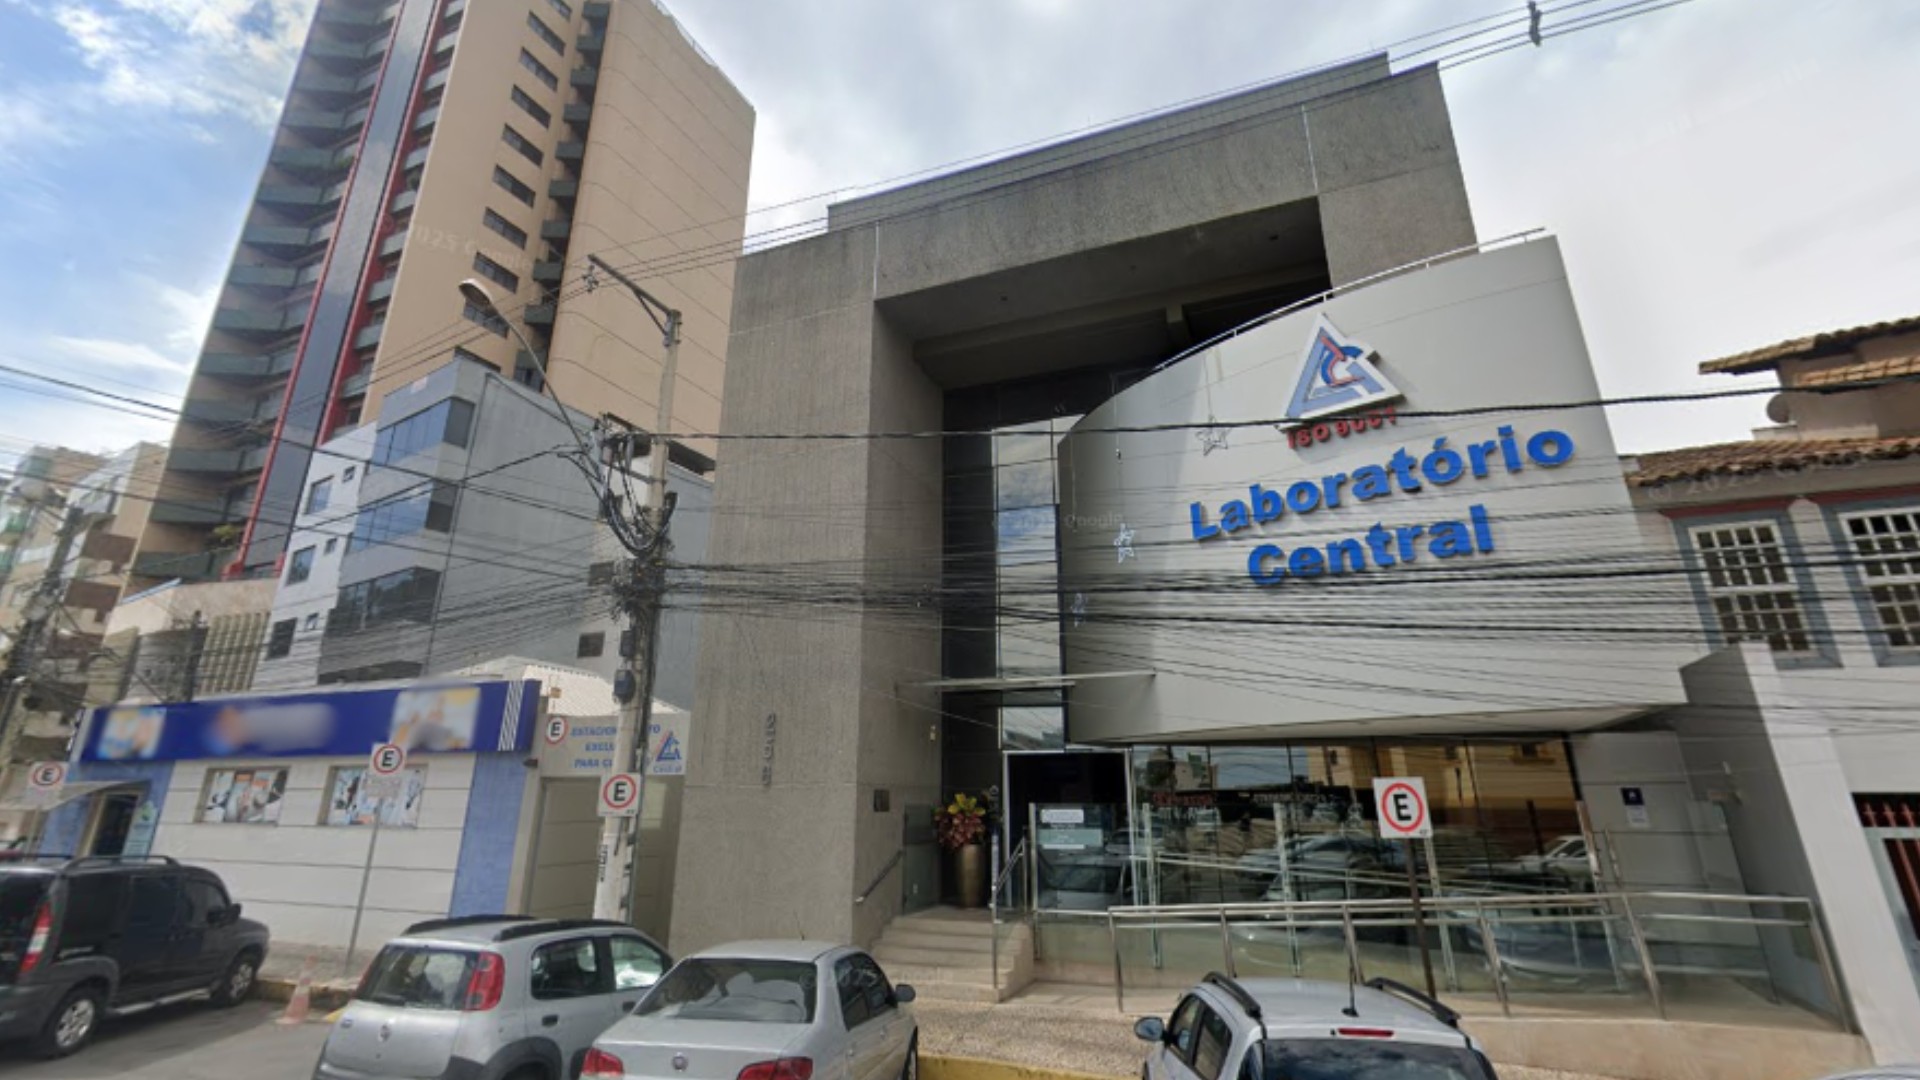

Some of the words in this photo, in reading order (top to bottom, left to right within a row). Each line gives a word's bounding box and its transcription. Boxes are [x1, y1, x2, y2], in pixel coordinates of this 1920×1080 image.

[1287, 422, 1330, 449] ISO
[1190, 424, 1574, 540] Laboratório
[1248, 504, 1494, 585] Central
[550, 721, 562, 736] E
[382, 750, 394, 767] E
[613, 781, 627, 802] E
[1393, 793, 1412, 821] E
